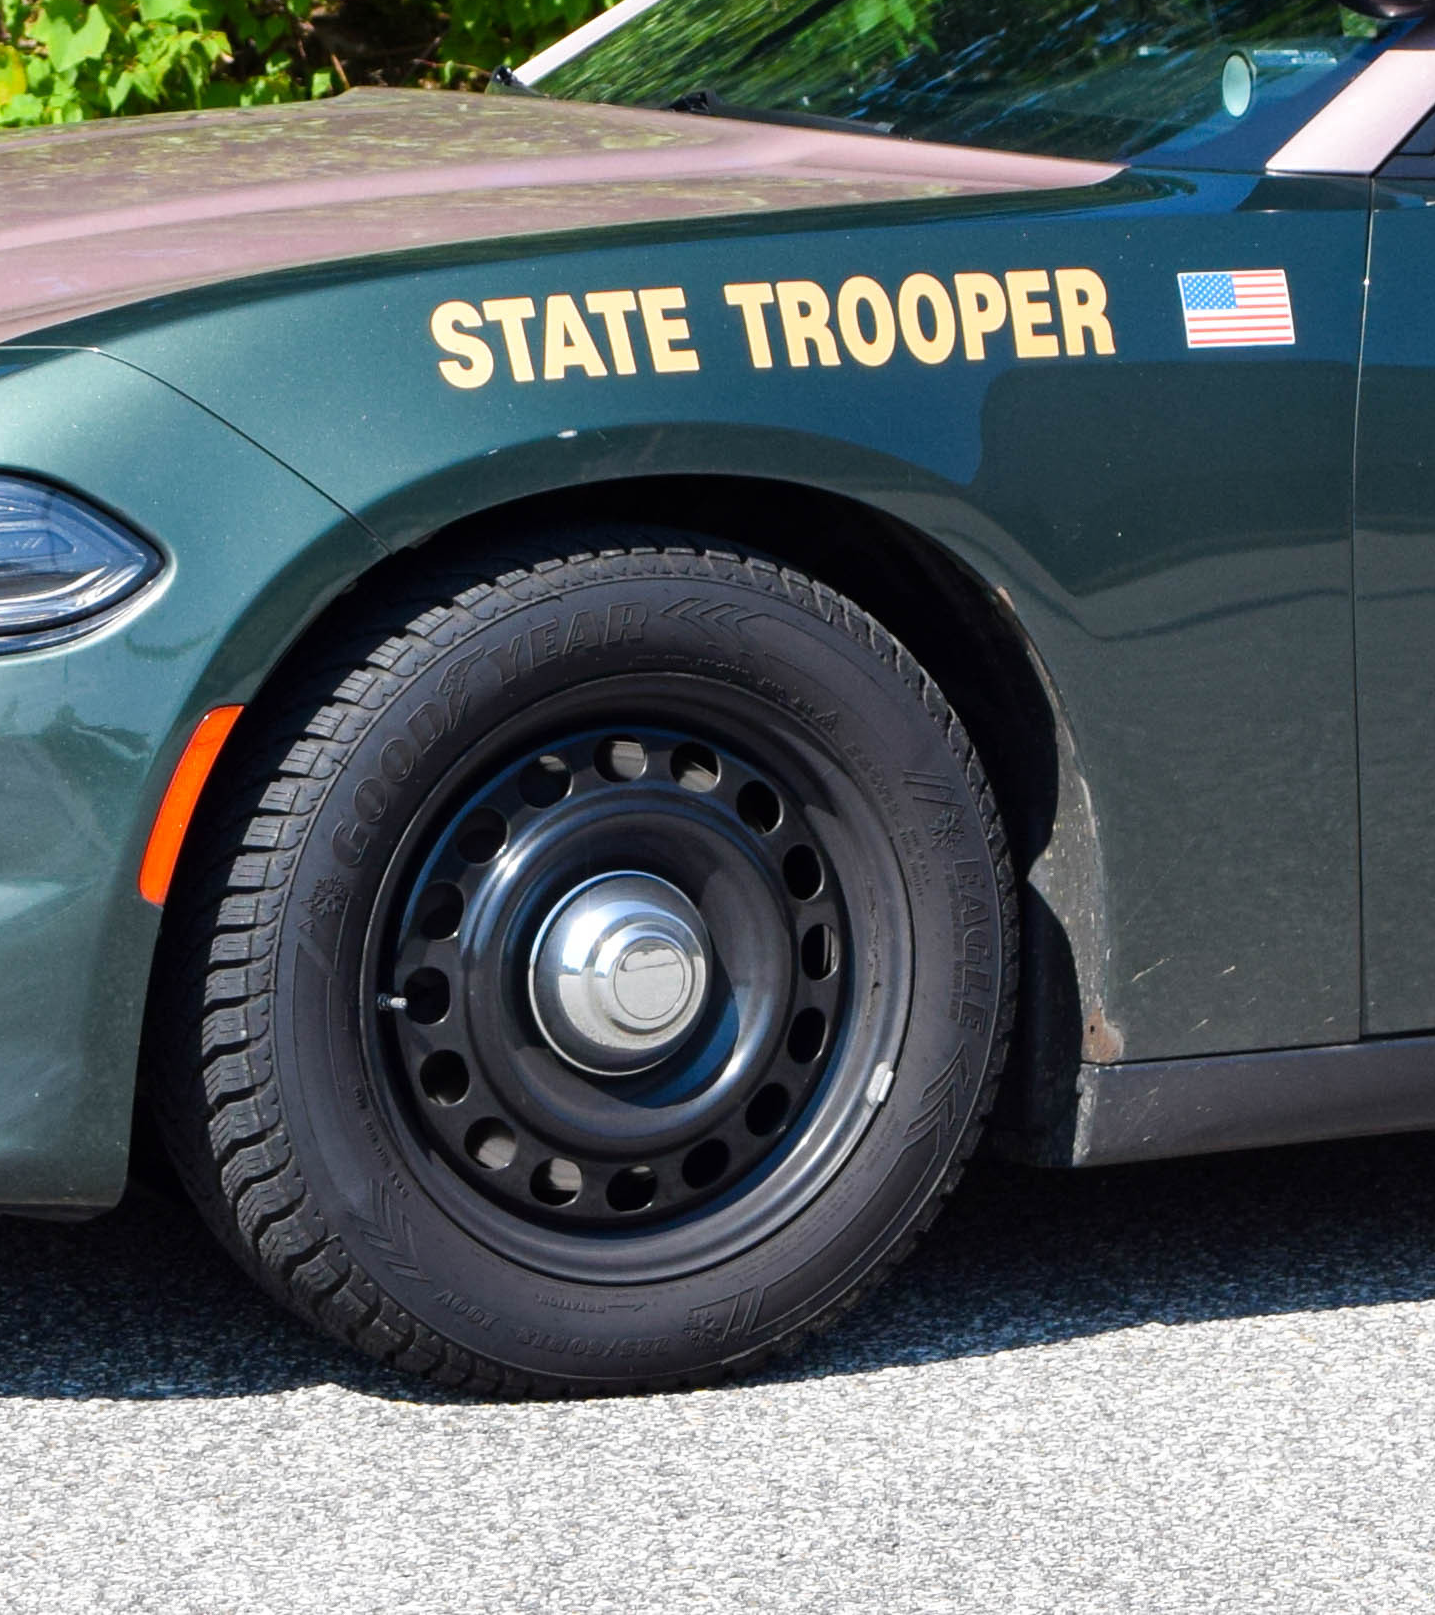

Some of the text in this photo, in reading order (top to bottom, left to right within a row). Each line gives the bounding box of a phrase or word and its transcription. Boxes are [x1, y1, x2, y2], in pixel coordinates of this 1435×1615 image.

[430, 268, 1116, 389] STATE TROOPER
[954, 858, 994, 1035] EAGLE
